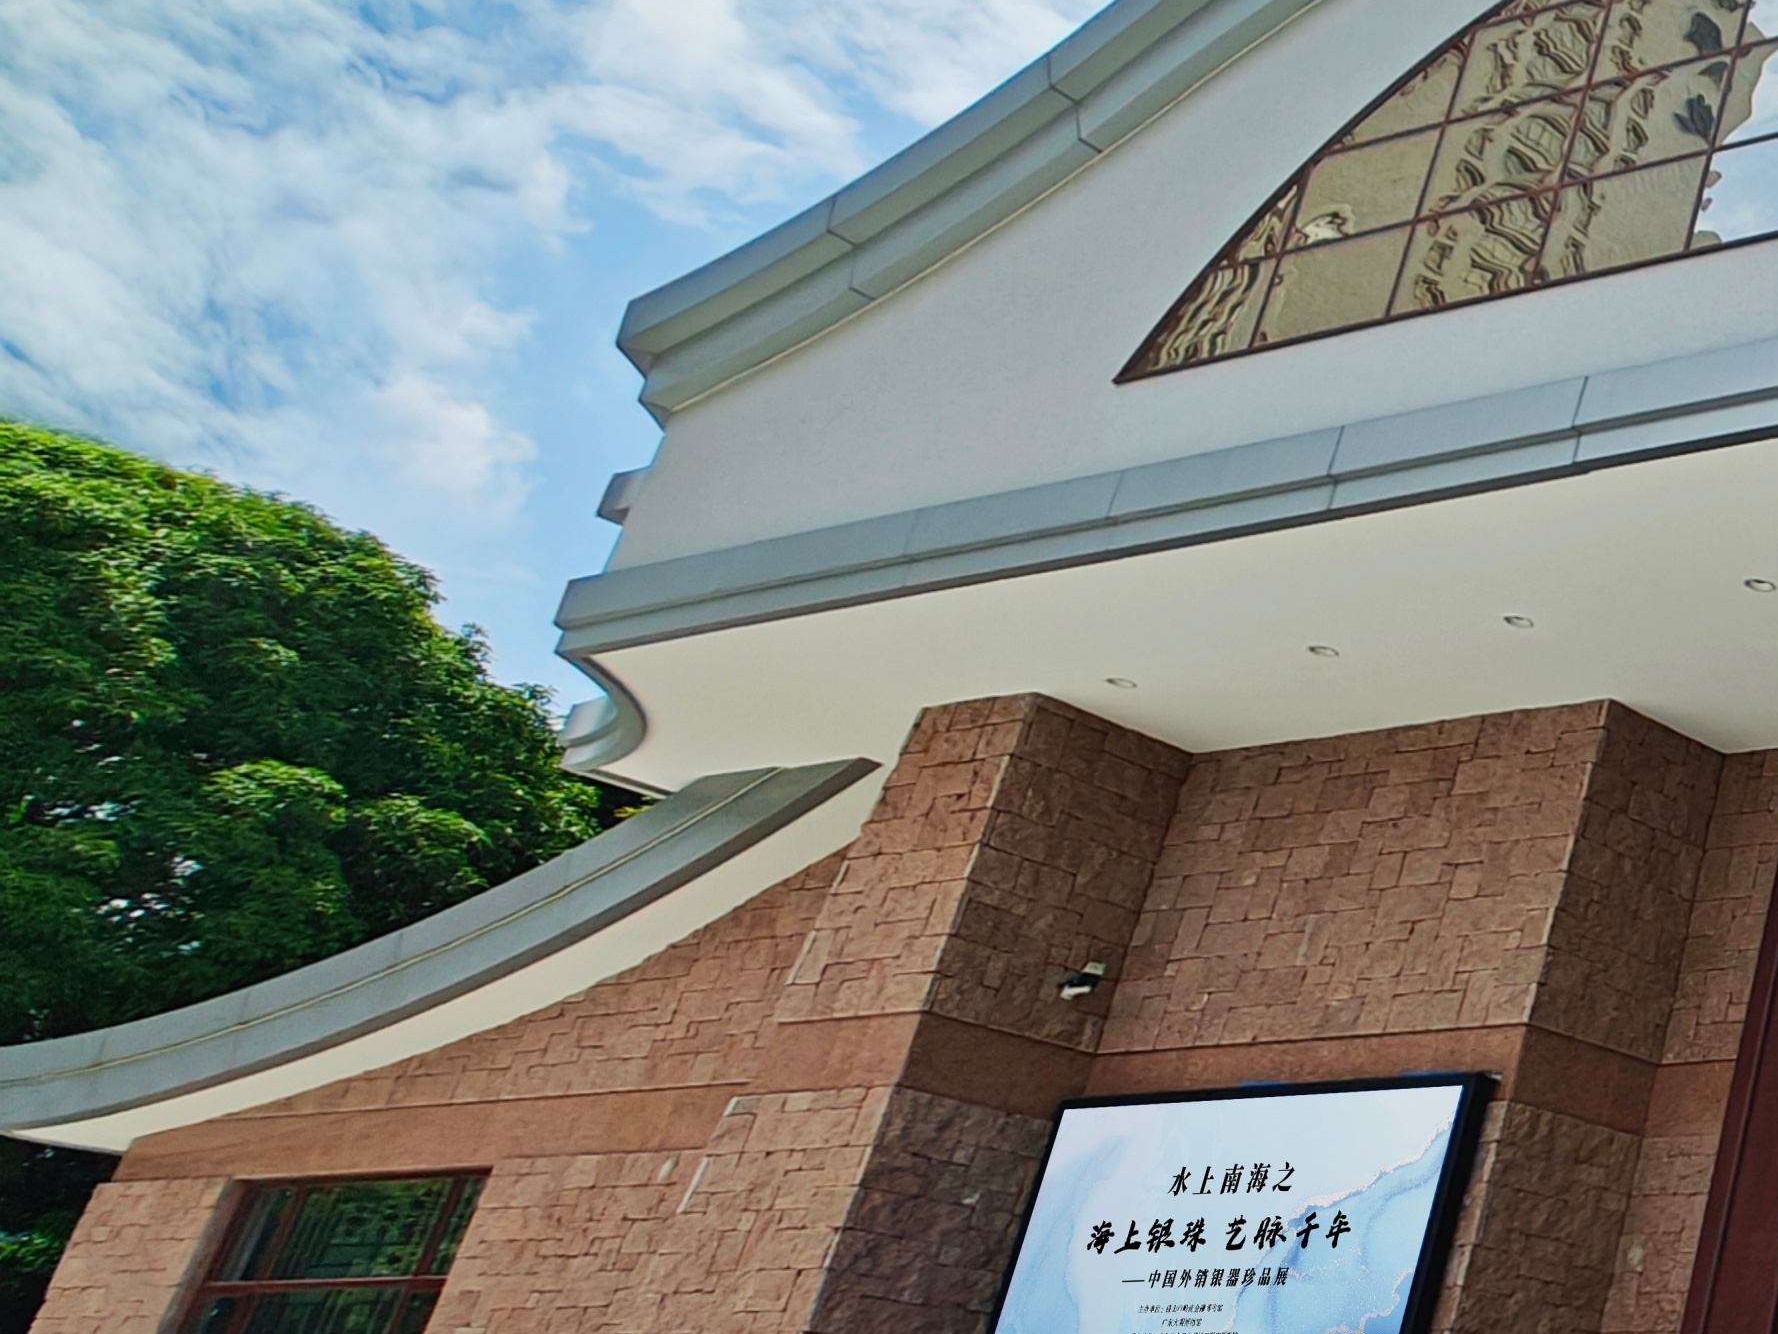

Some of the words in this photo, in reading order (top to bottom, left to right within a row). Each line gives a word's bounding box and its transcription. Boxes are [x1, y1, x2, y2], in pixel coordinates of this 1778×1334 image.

[1166, 1161, 1296, 1197] 水上南海之
